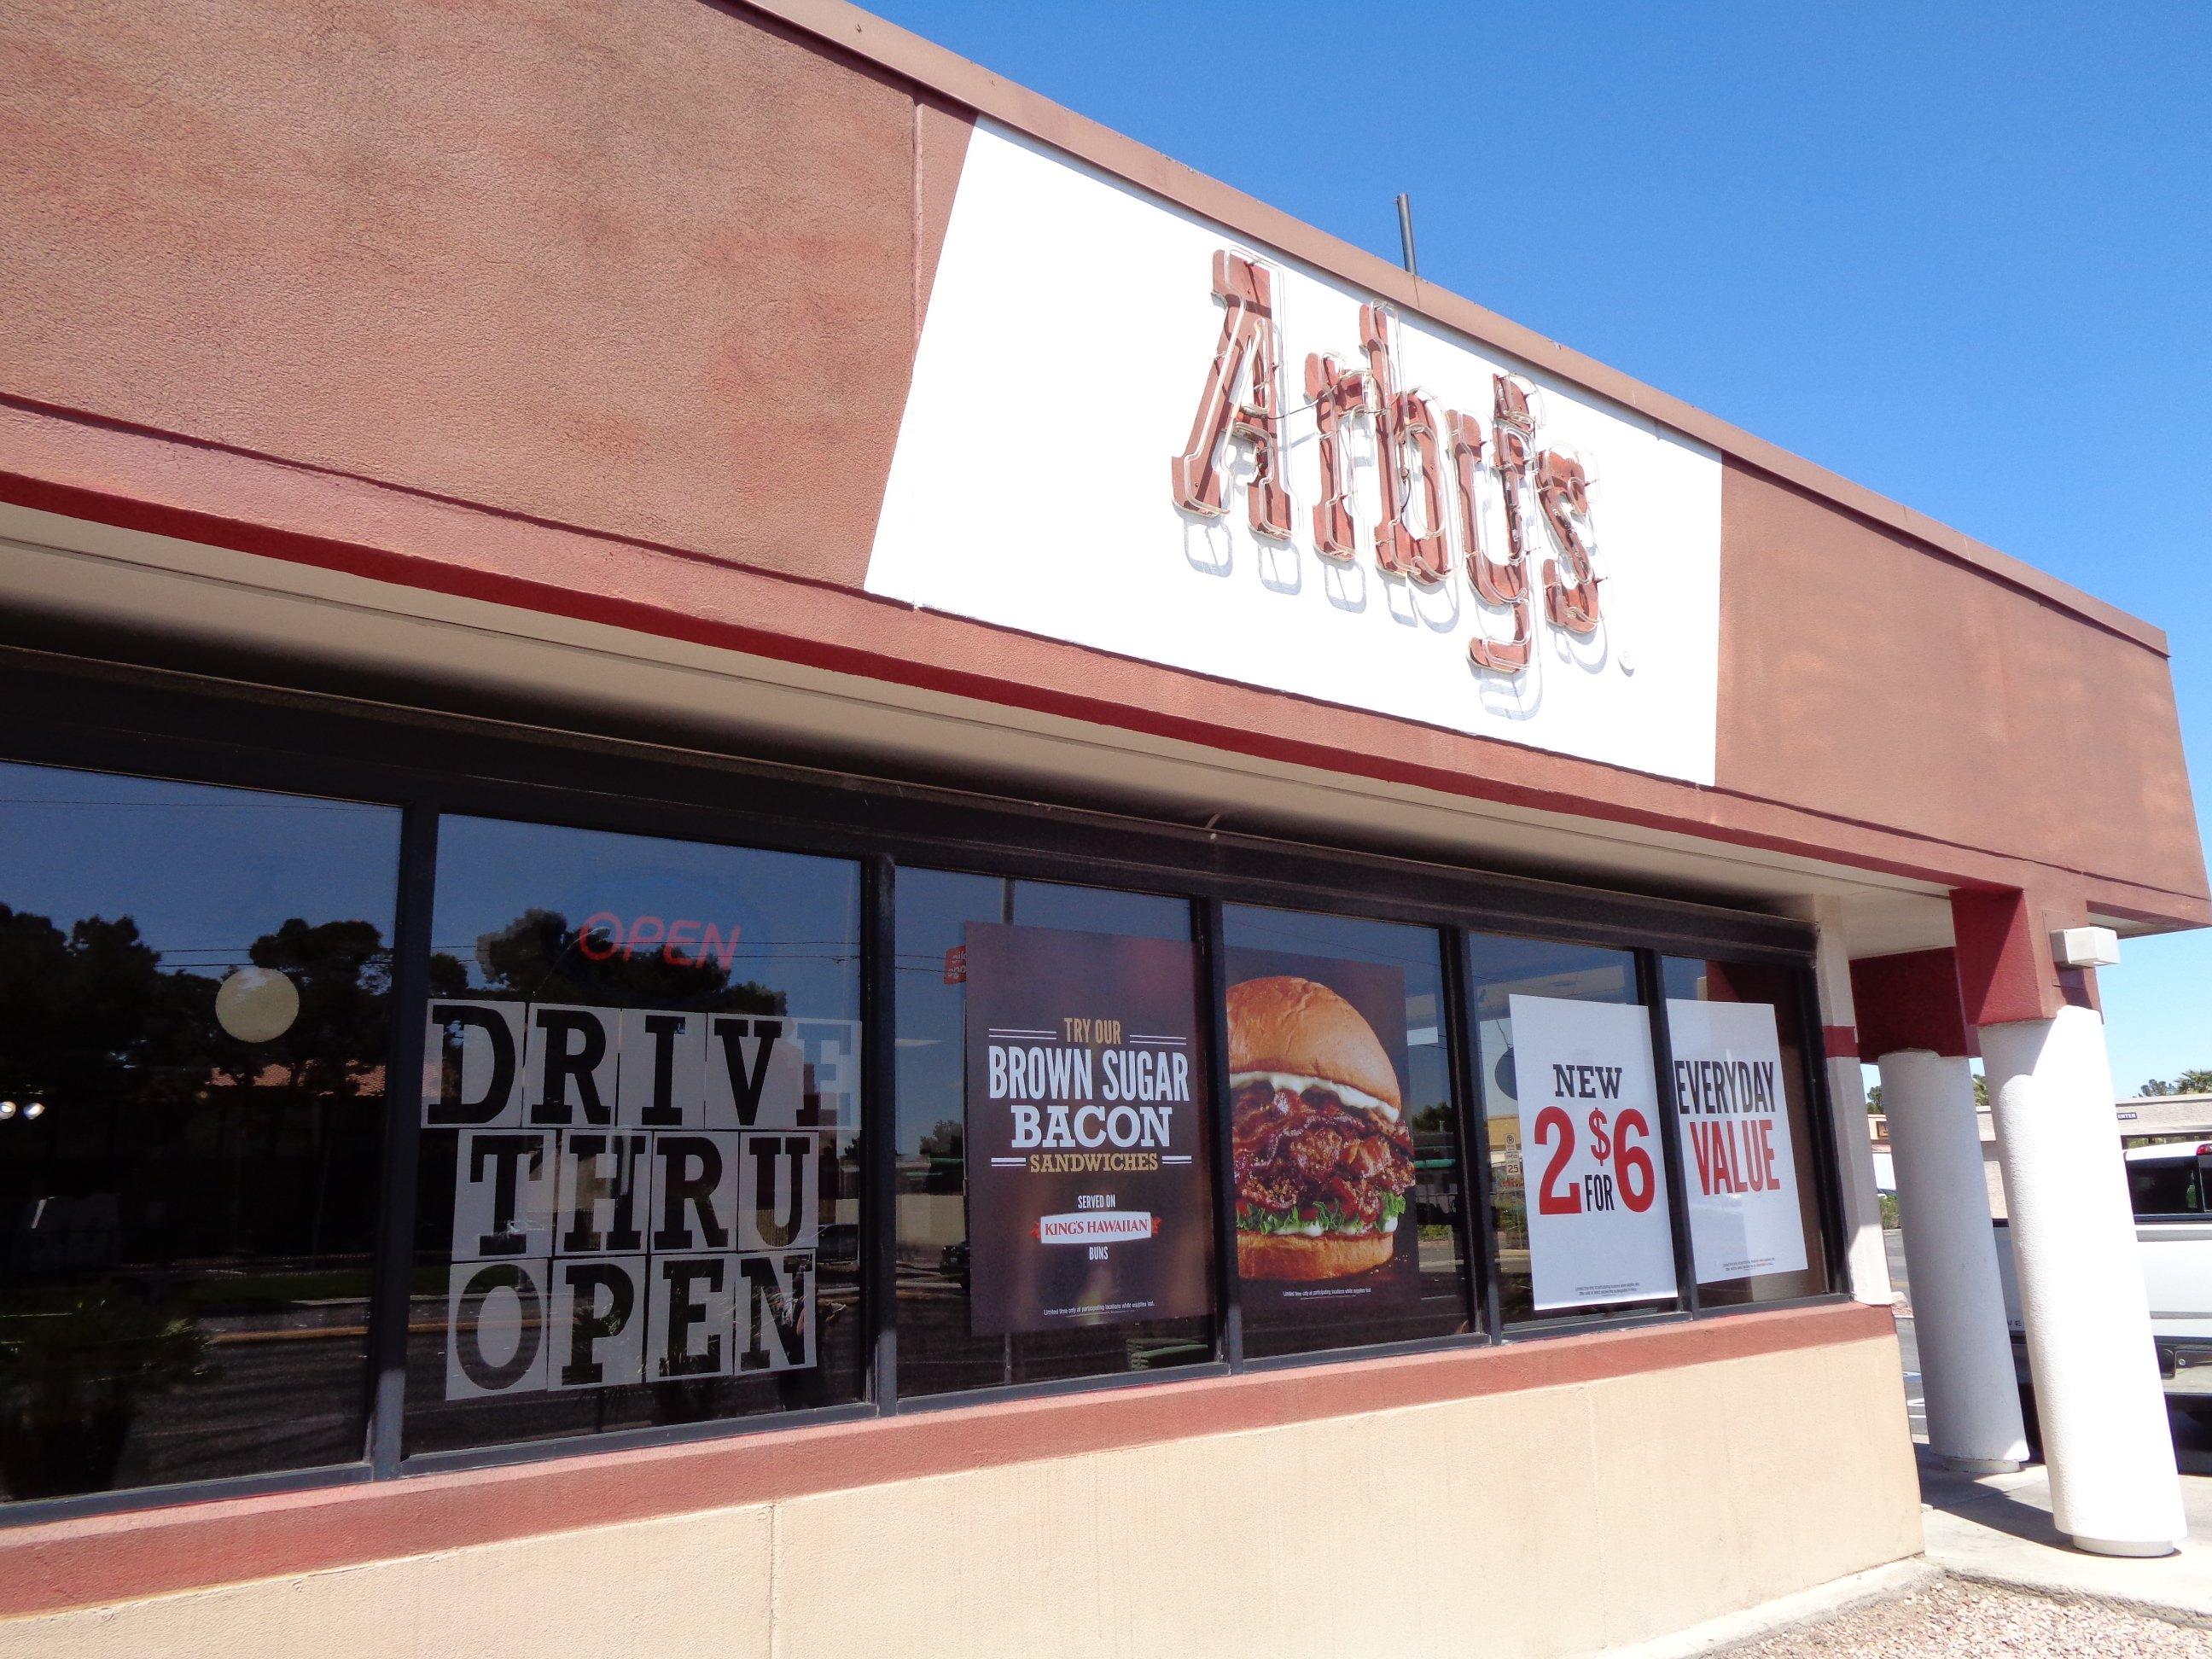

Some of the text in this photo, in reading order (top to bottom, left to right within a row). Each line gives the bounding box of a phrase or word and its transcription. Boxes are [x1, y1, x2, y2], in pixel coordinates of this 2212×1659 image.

[1171, 246, 1603, 674] Arby's
[579, 911, 742, 971] OPEN
[1064, 1017, 1121, 1045] TRY OUR
[428, 1004, 852, 1126] DRIVE
[988, 1045, 1190, 1102] BROWN SUGAR
[1552, 1063, 1622, 1099] NEW
[1674, 1060, 1776, 1115] EVERYDAY
[1010, 1105, 1173, 1148] BACON
[1029, 1153, 1159, 1173] SANDWICHES
[1507, 1164, 1519, 1173] 25
[1534, 1106, 1582, 1215] 2
[1584, 1174, 1615, 1212] FOR
[1690, 1119, 1780, 1196] VALUE
[469, 1134, 811, 1256] THRU
[1077, 1194, 1116, 1209] SERVED ON
[1045, 1219, 1148, 1236] KING'S HAWAIIAN
[1089, 1246, 1109, 1260] BUNS
[455, 1254, 813, 1391] OPEN
